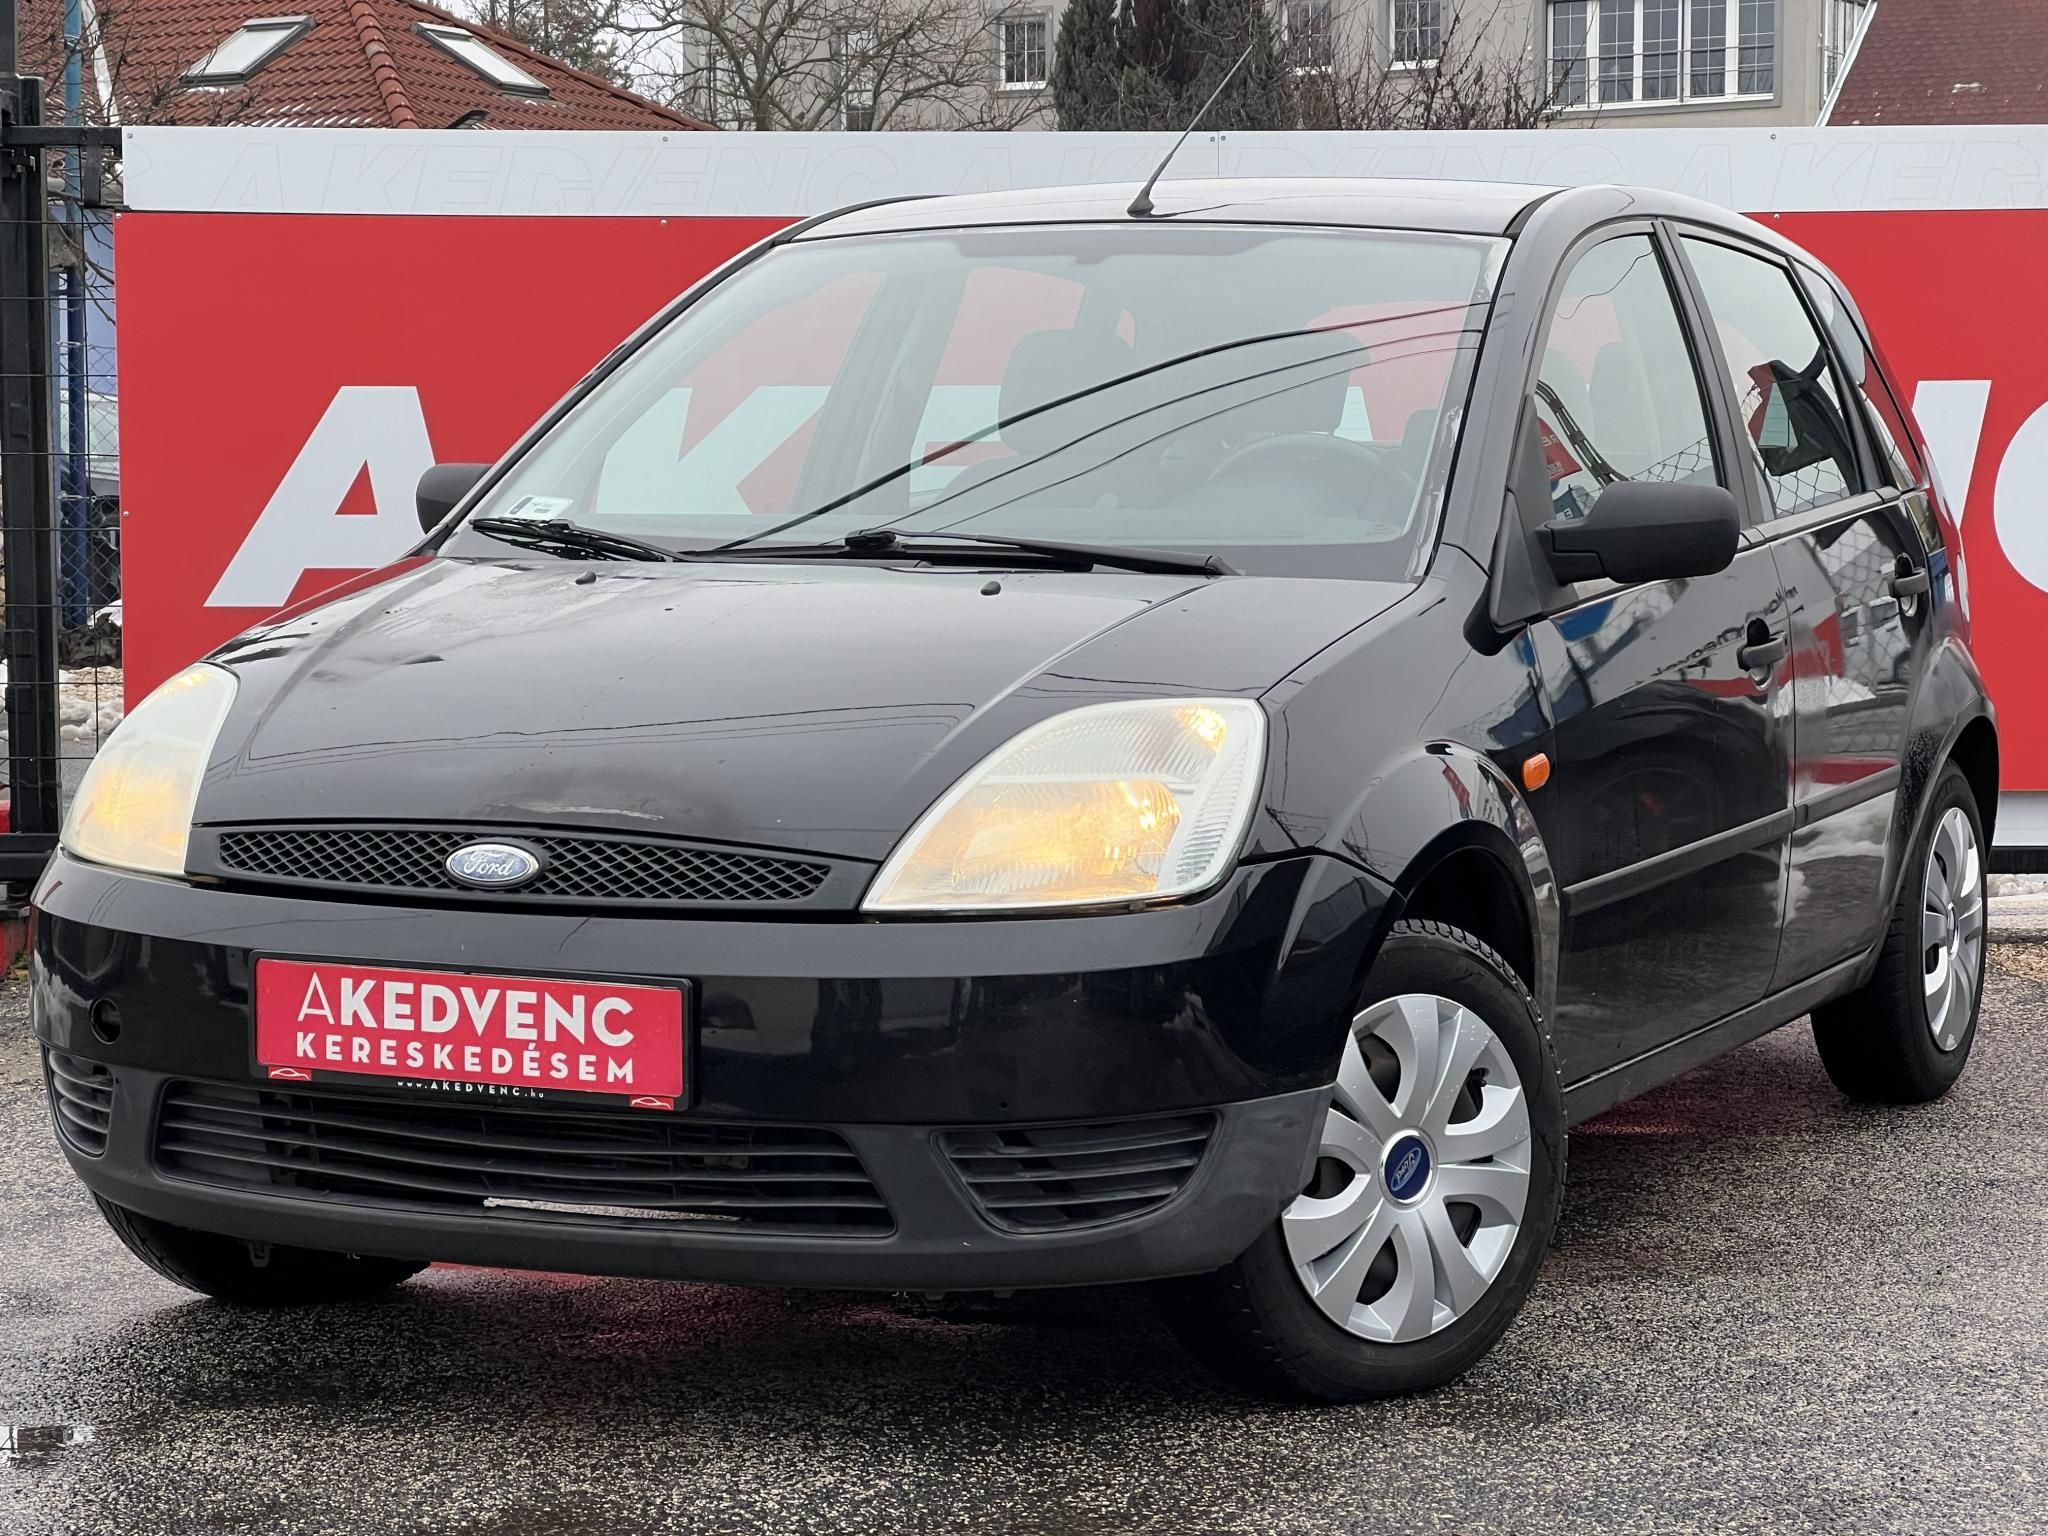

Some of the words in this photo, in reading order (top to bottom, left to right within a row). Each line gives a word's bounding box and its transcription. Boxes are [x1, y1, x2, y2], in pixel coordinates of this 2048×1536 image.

[463, 851, 516, 875] Ford
[295, 1031, 635, 1085] KERESKEDÉSEM
[397, 1080, 544, 1098] www.AKEDVENC.hu
